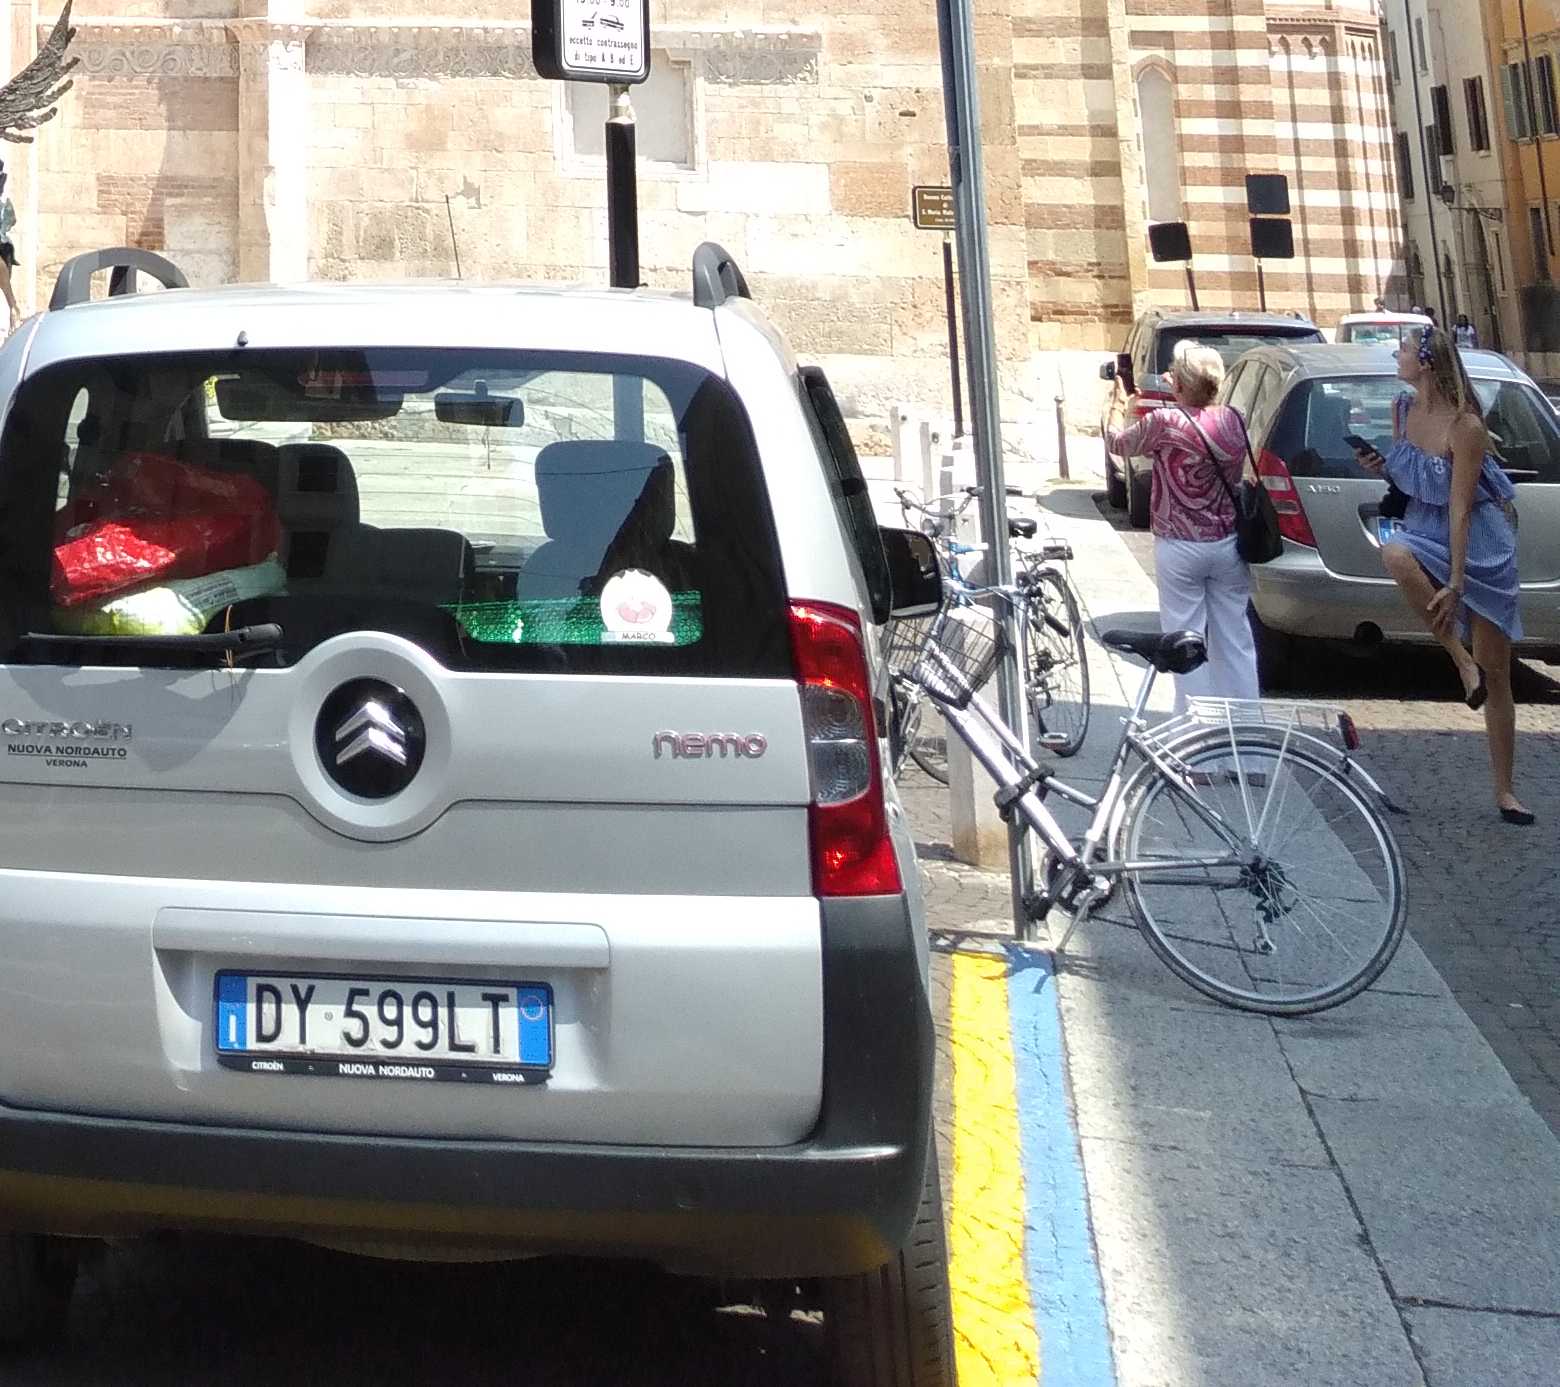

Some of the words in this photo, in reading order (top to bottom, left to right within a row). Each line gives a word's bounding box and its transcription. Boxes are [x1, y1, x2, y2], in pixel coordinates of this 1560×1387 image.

[569, 35, 593, 46] eccetto
[596, 38, 638, 51] contrassegno
[621, 632, 657, 641] MARCO
[7, 743, 53, 755] NUOVA
[55, 746, 127, 758] NORDAUTO
[652, 729, 768, 759] nemo
[45, 759, 88, 768] VERONA
[255, 982, 316, 1045] DY
[342, 986, 510, 1055] 599LT
[251, 1060, 284, 1071] CITROËN
[339, 1063, 376, 1075] NUOVA
[378, 1065, 435, 1078] NORDAUTO
[492, 1072, 525, 1083] VERONA
